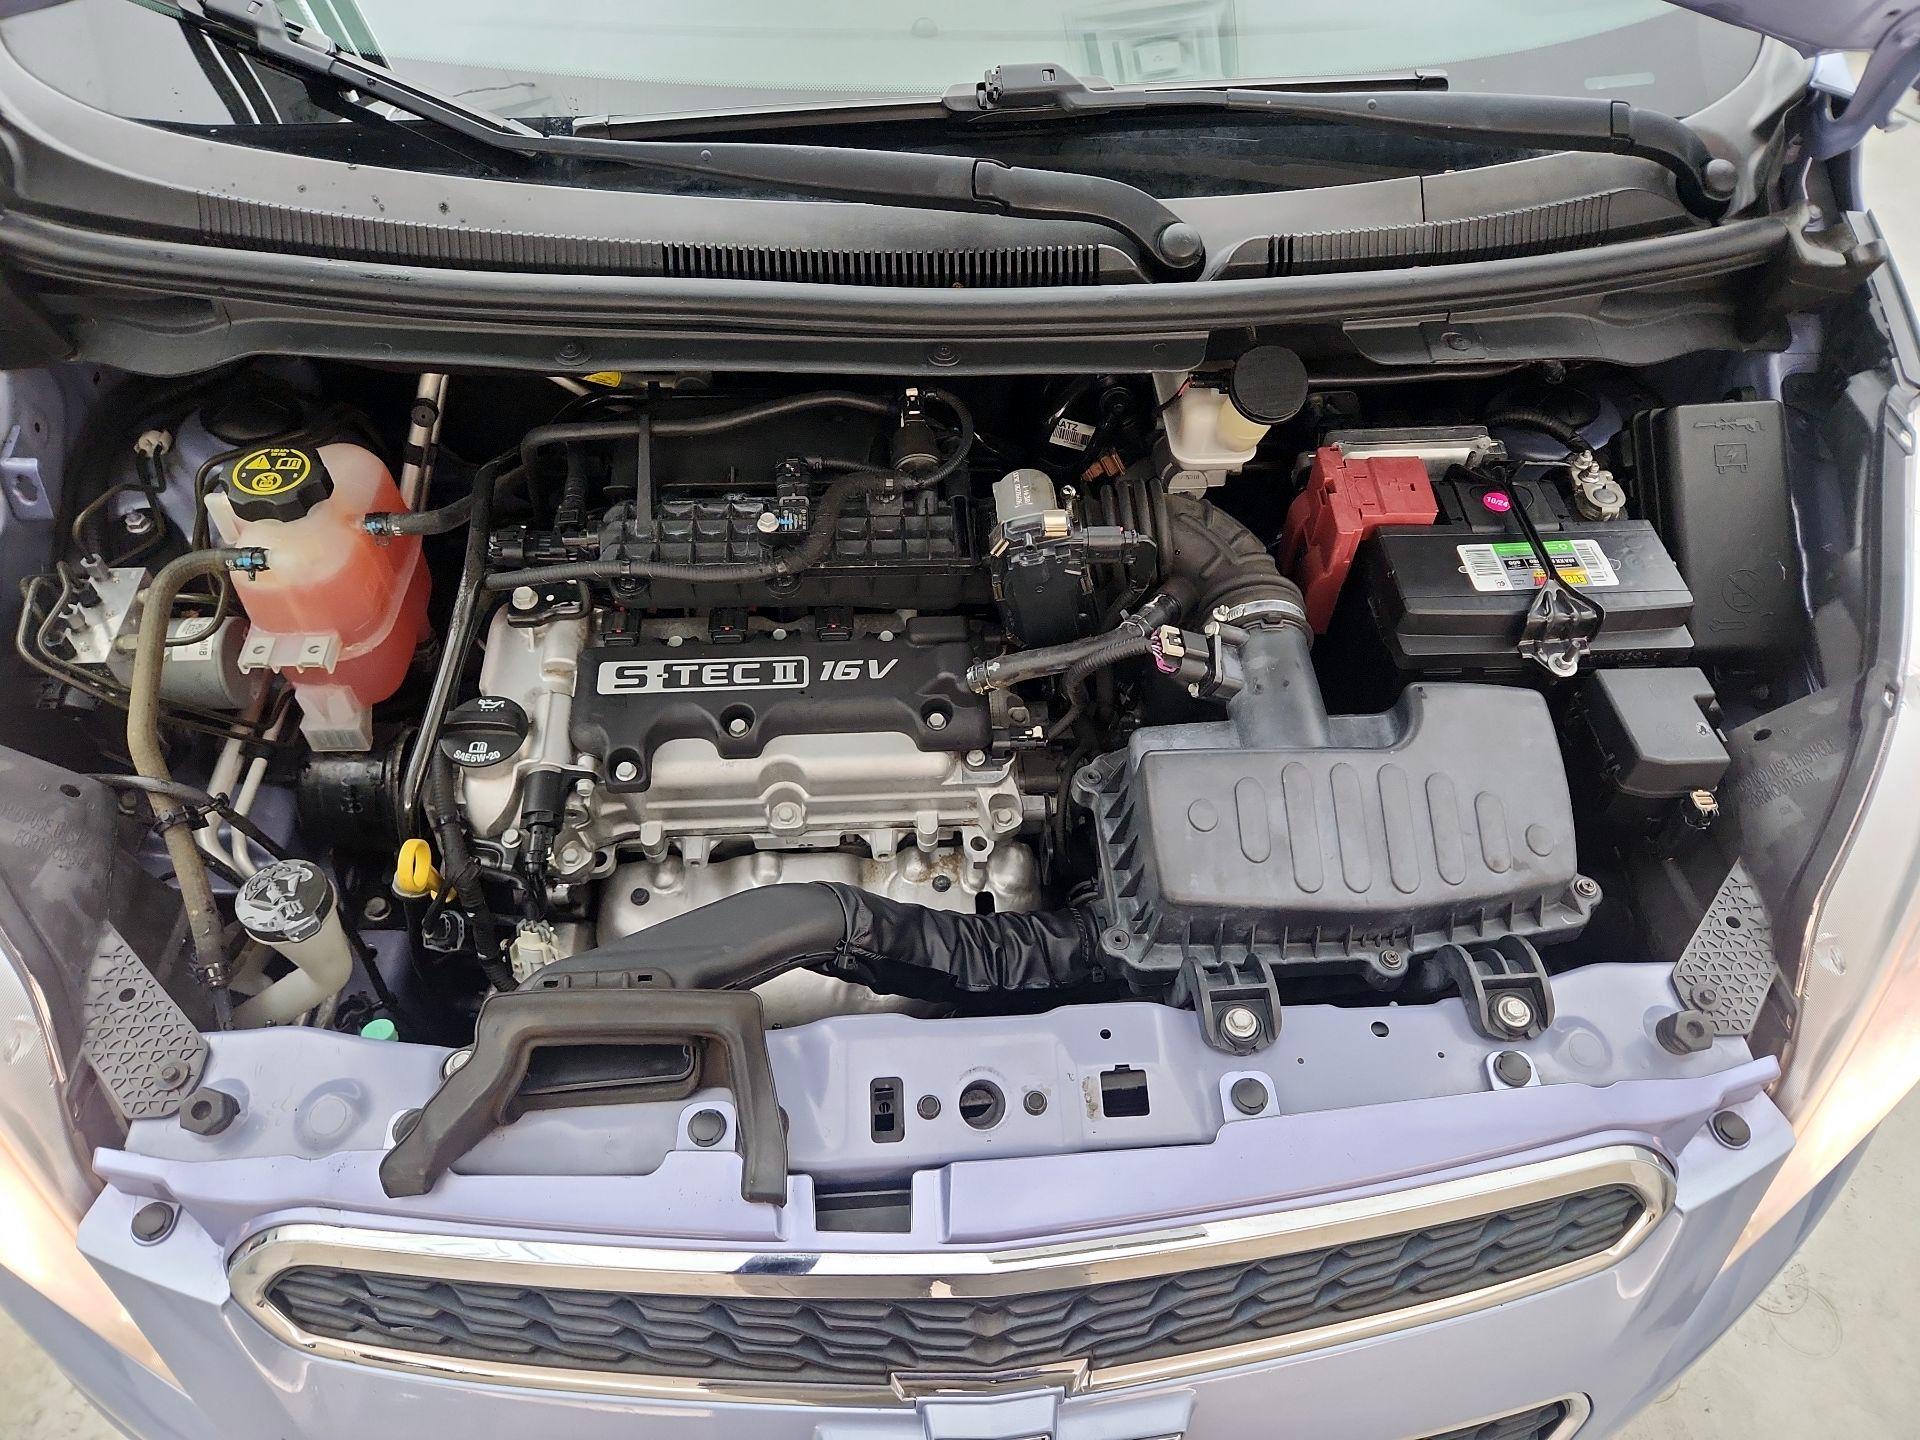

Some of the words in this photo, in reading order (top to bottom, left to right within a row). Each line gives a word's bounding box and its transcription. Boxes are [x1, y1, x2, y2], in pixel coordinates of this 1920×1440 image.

[1486, 496, 1508, 508] 10/24
[613, 662, 761, 690] S-TEC
[819, 658, 899, 682] 16V
